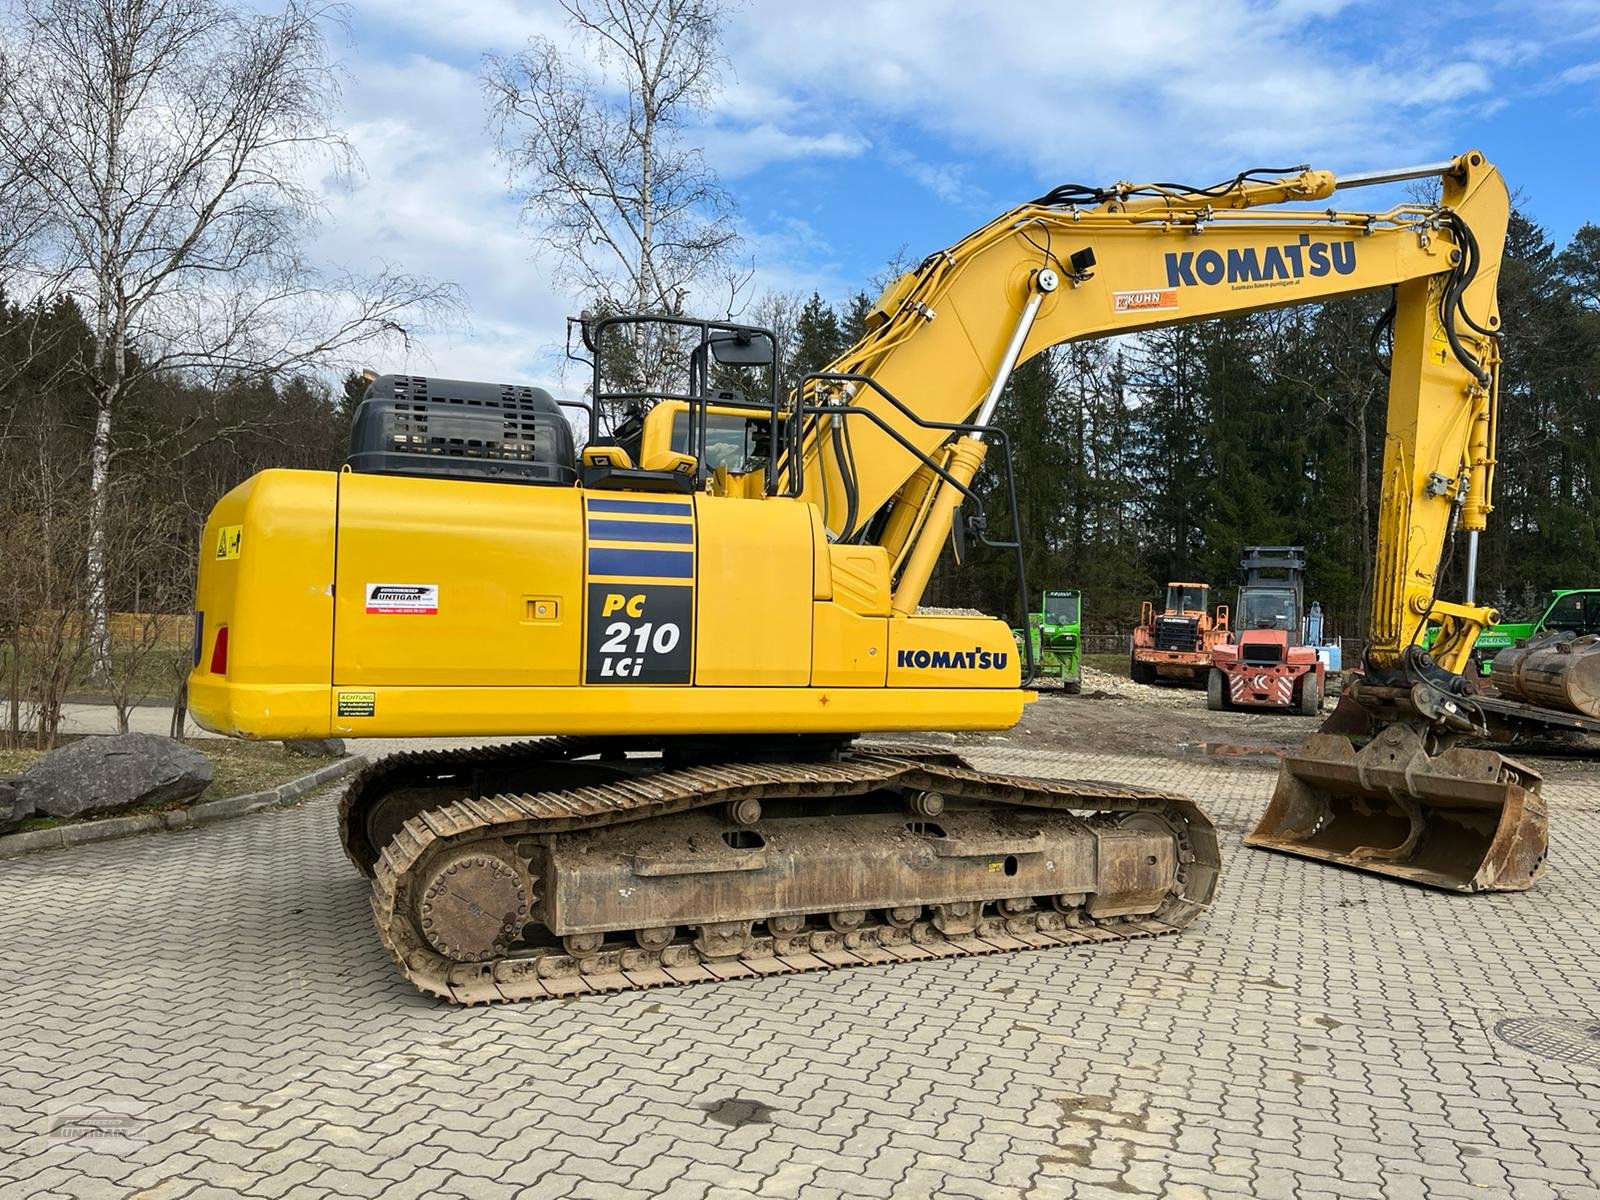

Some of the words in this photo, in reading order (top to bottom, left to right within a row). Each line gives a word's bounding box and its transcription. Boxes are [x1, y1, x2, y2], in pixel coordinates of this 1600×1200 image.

[1165, 234, 1357, 288] KOMATSU
[1127, 292, 1161, 304] KUHN
[602, 593, 646, 618] PC
[599, 621, 680, 654] 210
[600, 657, 644, 677] LCi
[897, 647, 1008, 670] KOMATSU
